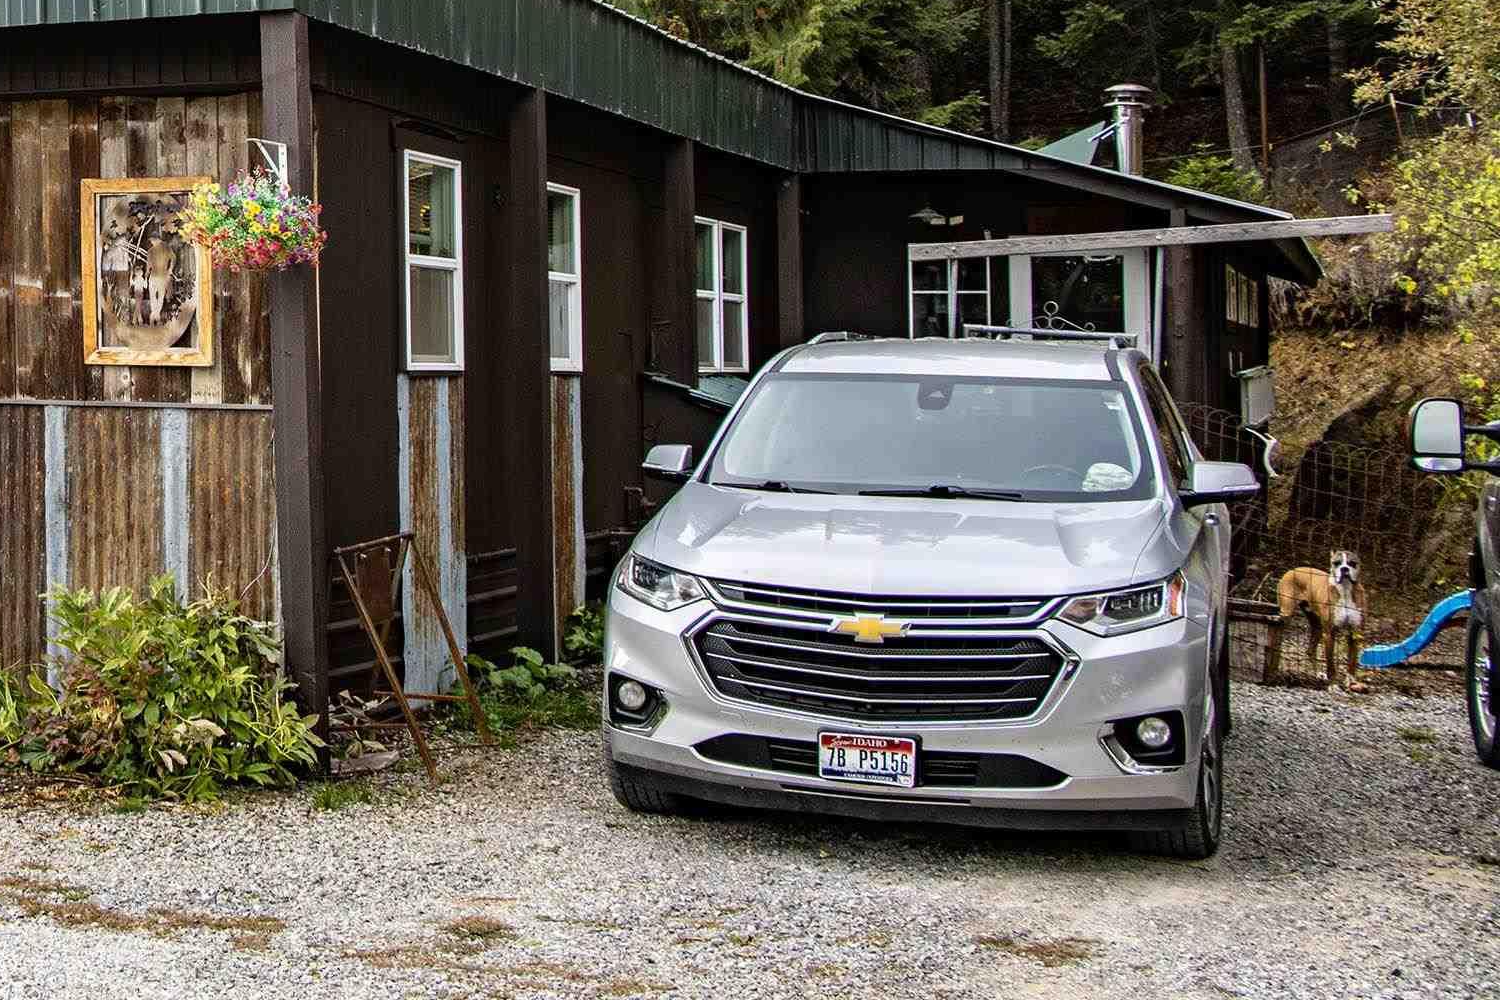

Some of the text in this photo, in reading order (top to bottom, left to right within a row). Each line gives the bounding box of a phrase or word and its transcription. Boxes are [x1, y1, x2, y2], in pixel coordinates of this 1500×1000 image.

[852, 737, 888, 748] IDAHO
[827, 747, 908, 774] 7B P5156
